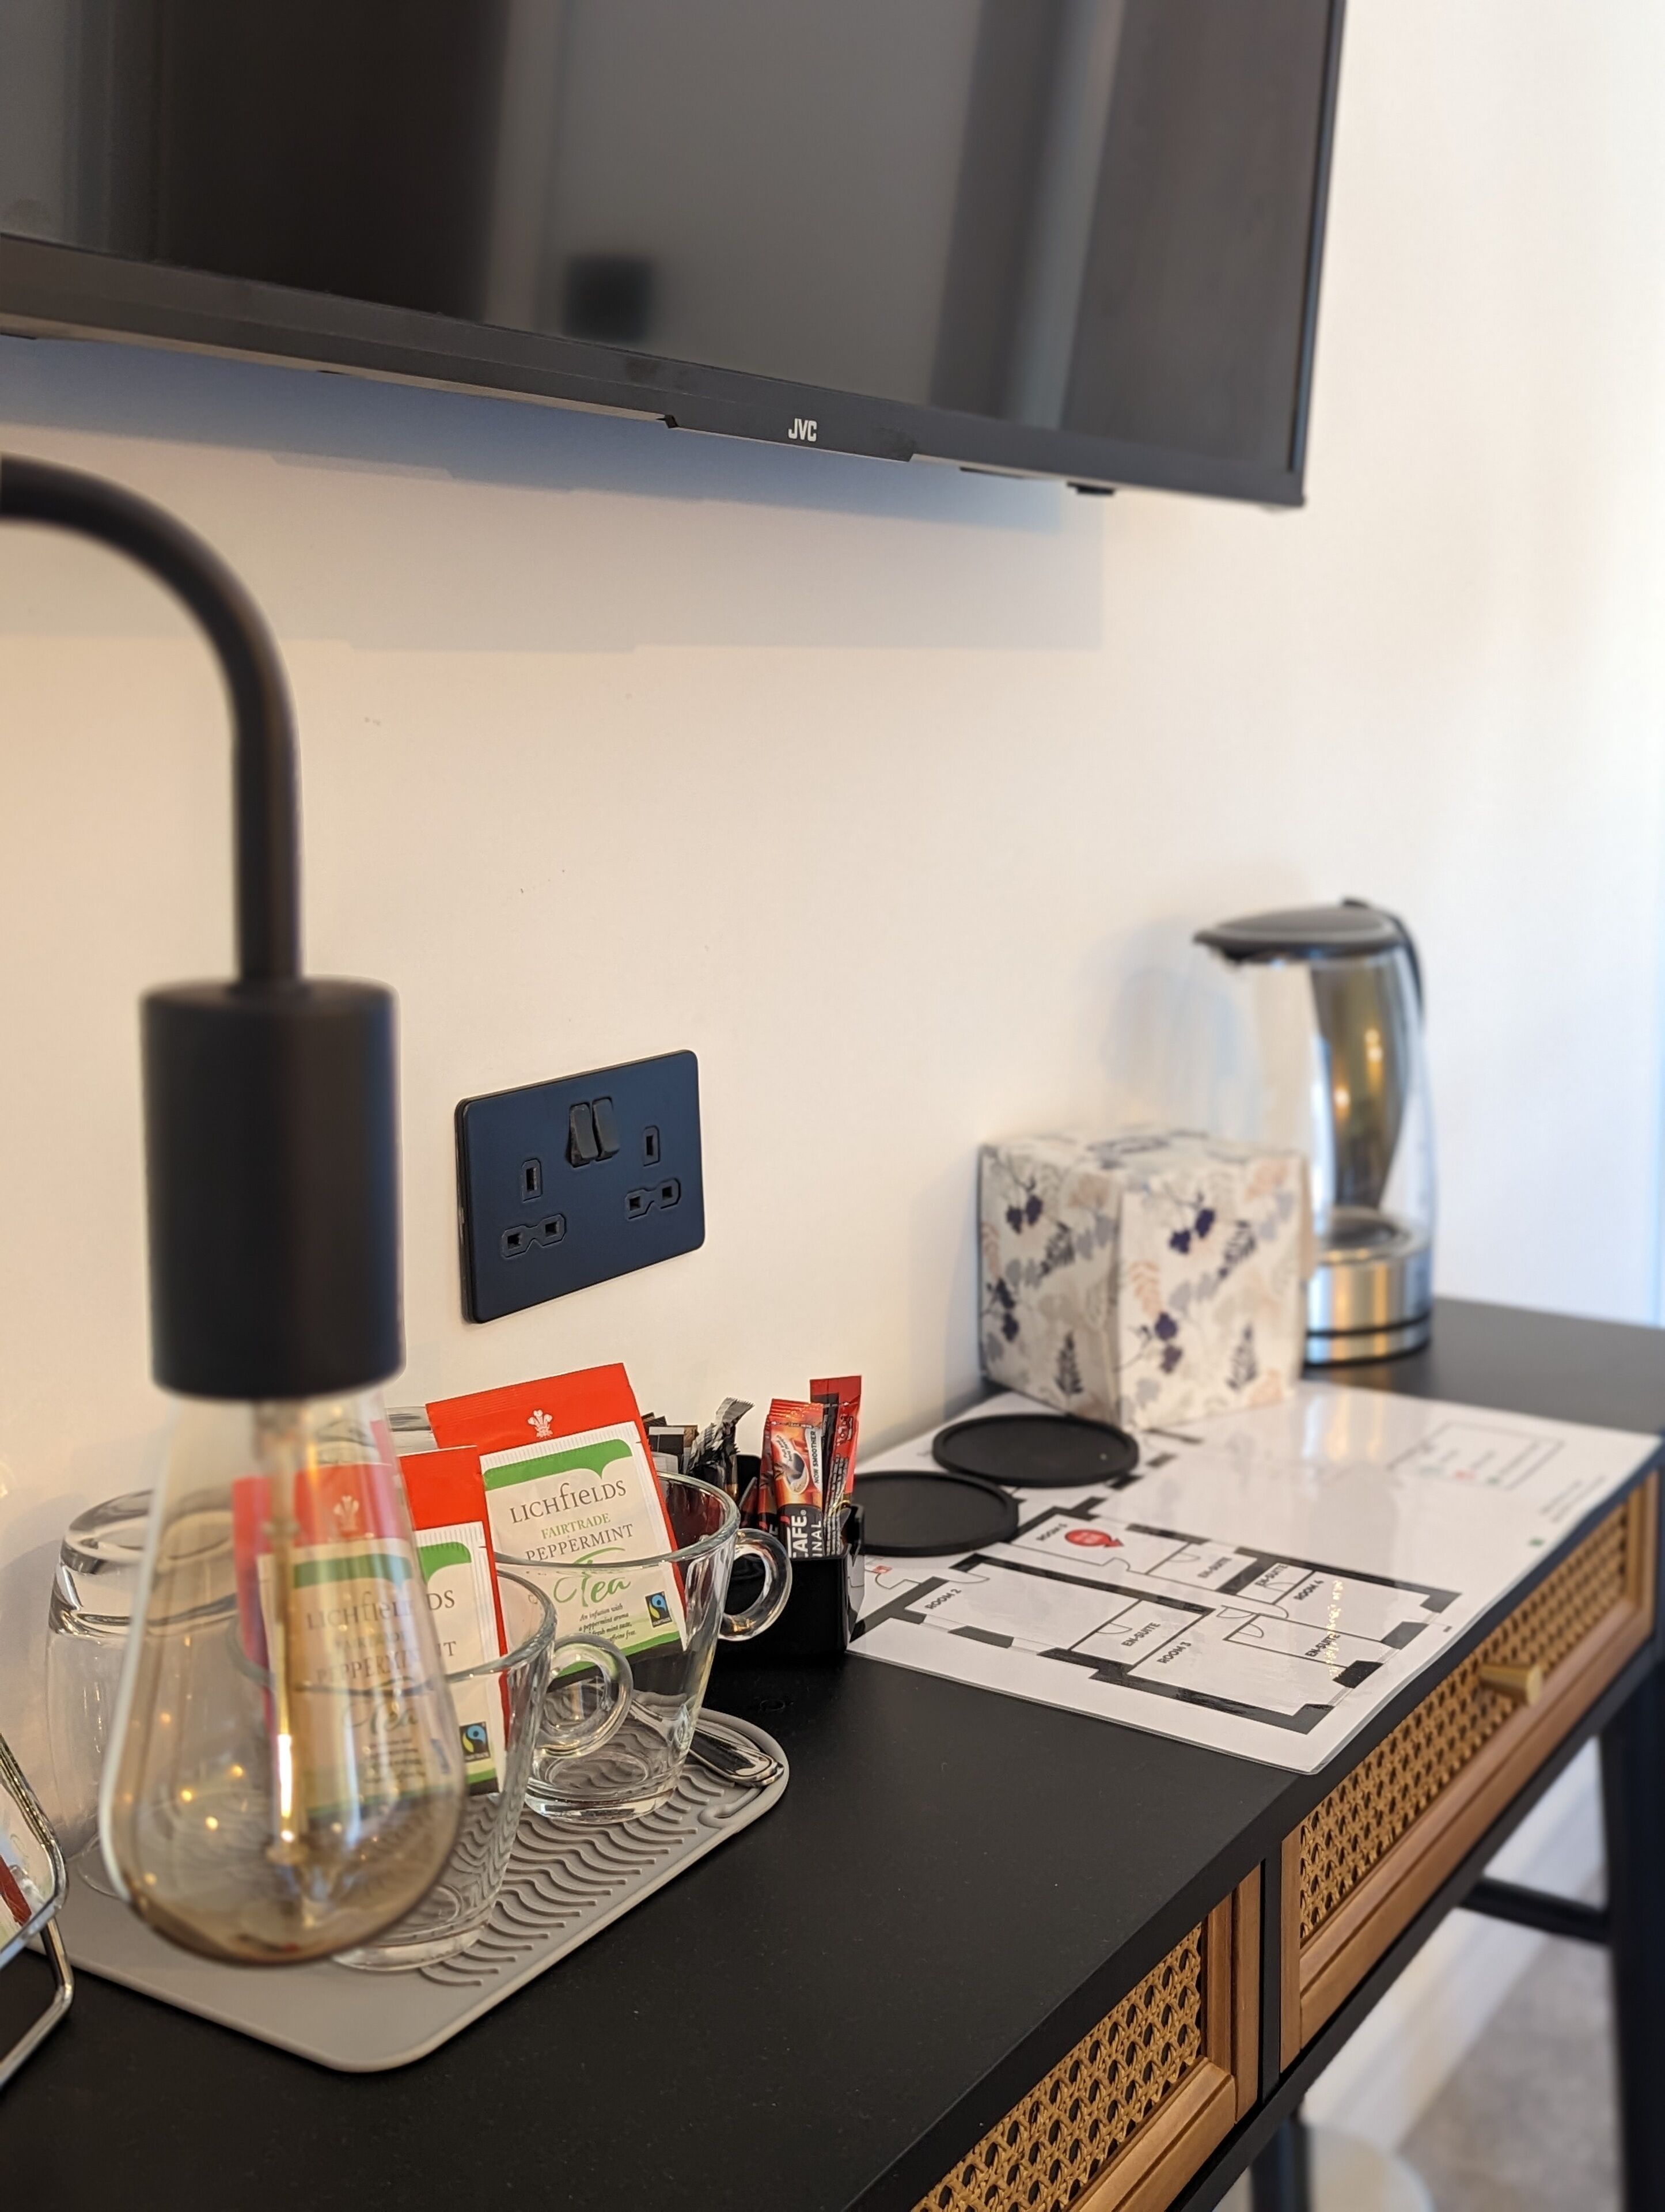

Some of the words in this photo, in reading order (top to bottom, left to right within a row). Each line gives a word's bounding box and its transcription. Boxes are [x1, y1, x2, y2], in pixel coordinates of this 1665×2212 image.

[788, 418, 817, 442] JVC
[810, 1430, 819, 1467] SMOOTHER
[541, 1513, 610, 1539] FAIRTRADE
[525, 1524, 634, 1562] PEPPERMINT
[1254, 1564, 1288, 1588] EN-SUITE
[924, 1592, 955, 1609] ROOM
[1293, 1584, 1319, 1600] ROOM
[1121, 1622, 1161, 1646] EN-SUITE
[1304, 1633, 1341, 1657] EN-SUITE
[1156, 1646, 1186, 1664] ROOM
